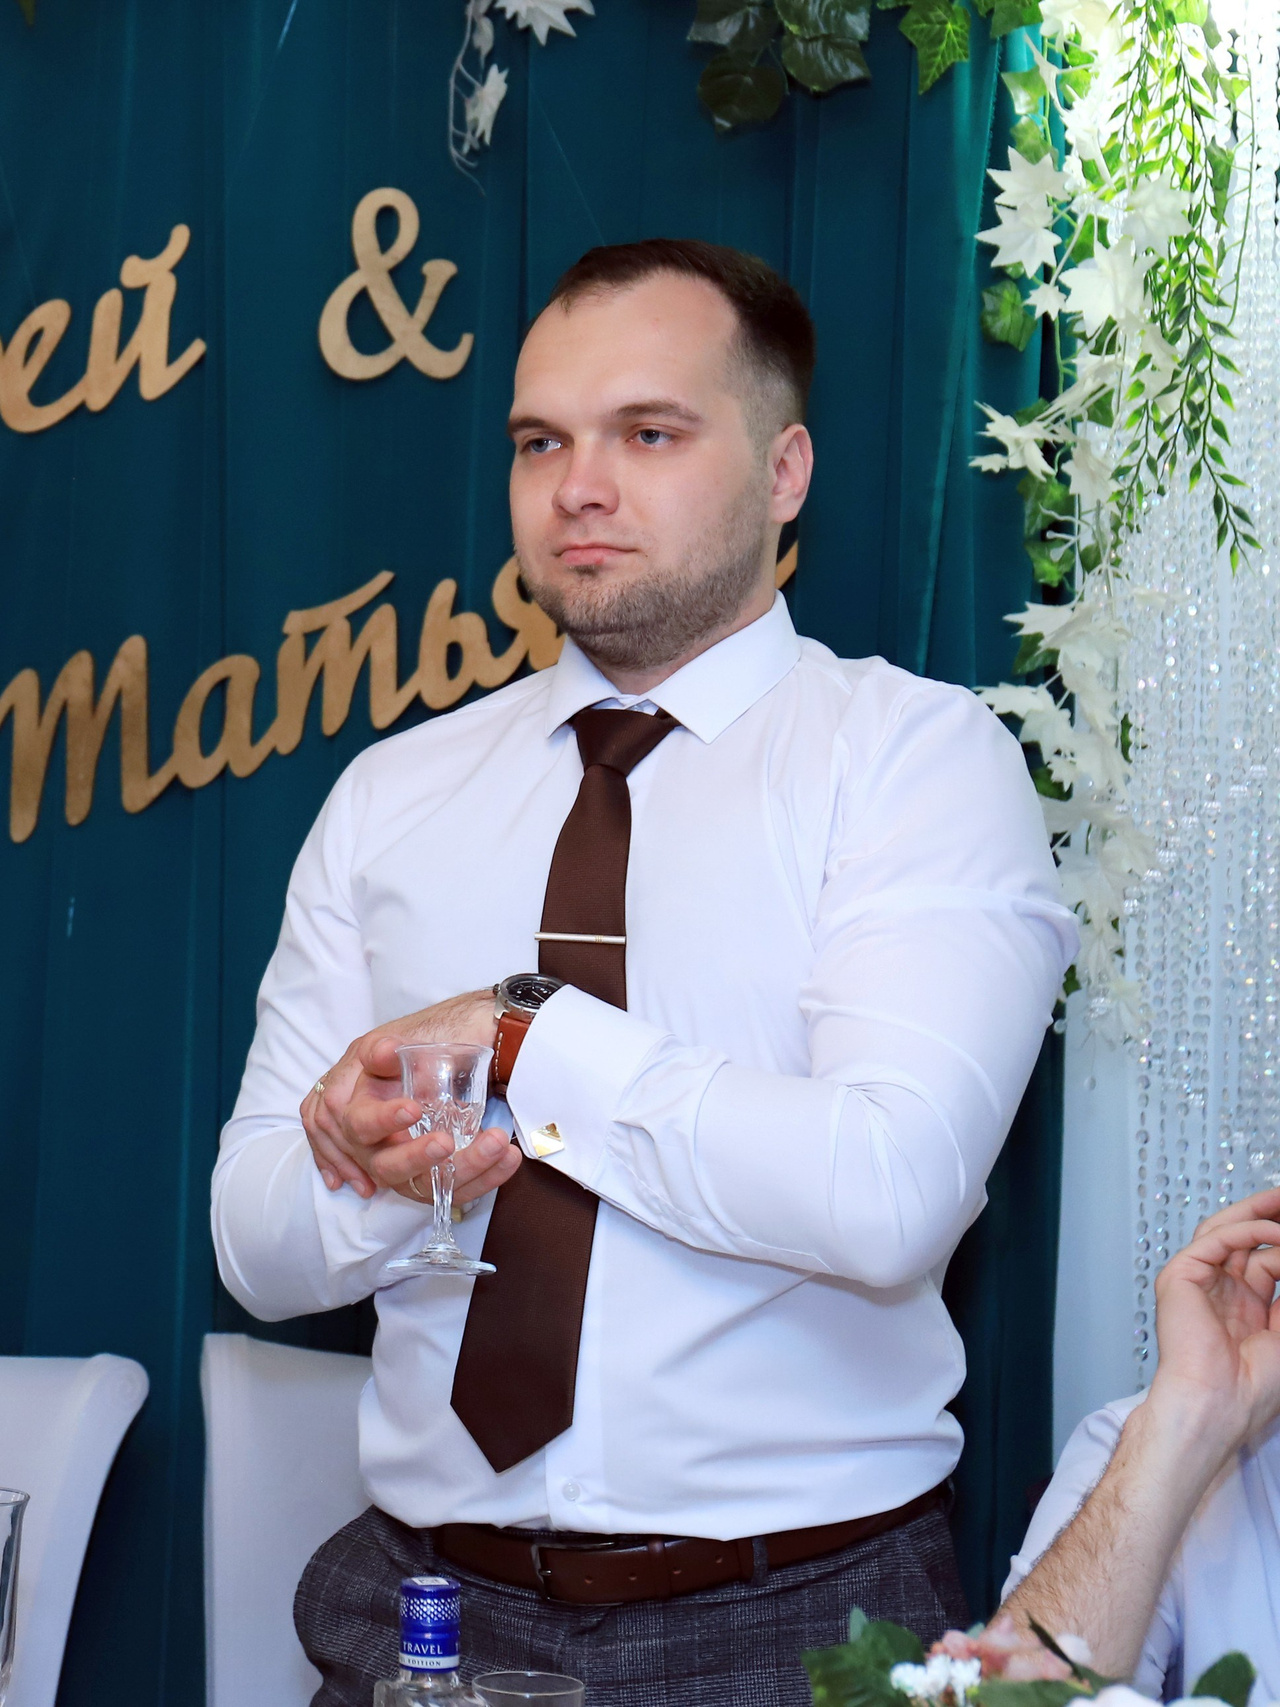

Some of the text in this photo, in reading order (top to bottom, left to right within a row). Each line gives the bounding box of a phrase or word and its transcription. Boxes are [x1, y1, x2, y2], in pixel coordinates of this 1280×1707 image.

[317, 187, 475, 381] &
[403, 1641, 443, 1655] TRAVEL
[408, 1658, 441, 1667] EDITION
